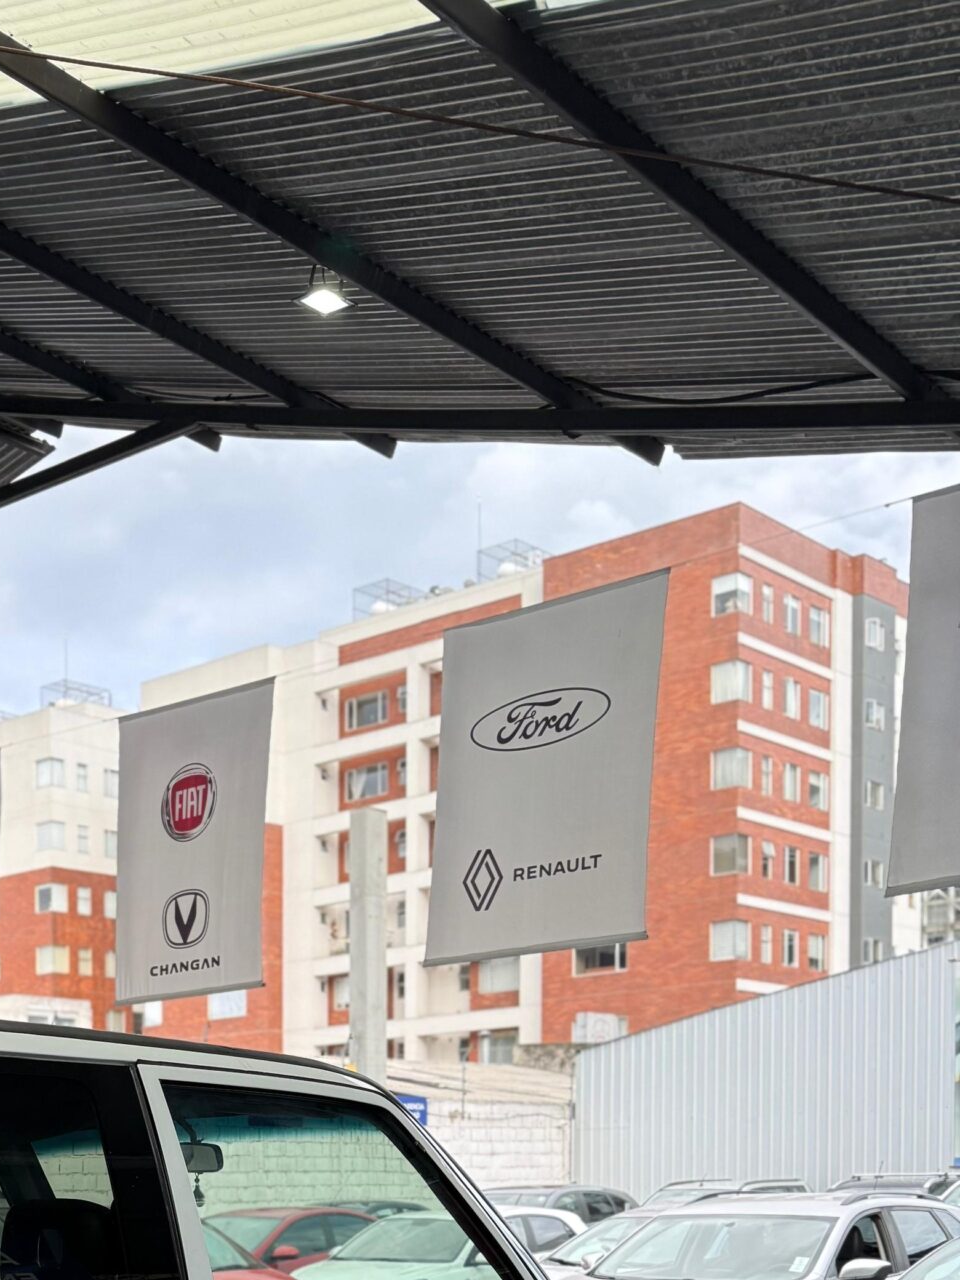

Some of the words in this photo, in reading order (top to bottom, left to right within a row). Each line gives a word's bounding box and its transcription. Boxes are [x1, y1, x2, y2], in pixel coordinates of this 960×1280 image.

[497, 697, 583, 745] Ford
[175, 784, 207, 822] FIAT
[513, 854, 602, 881] RENAULT
[150, 955, 221, 977] CHANGAN
